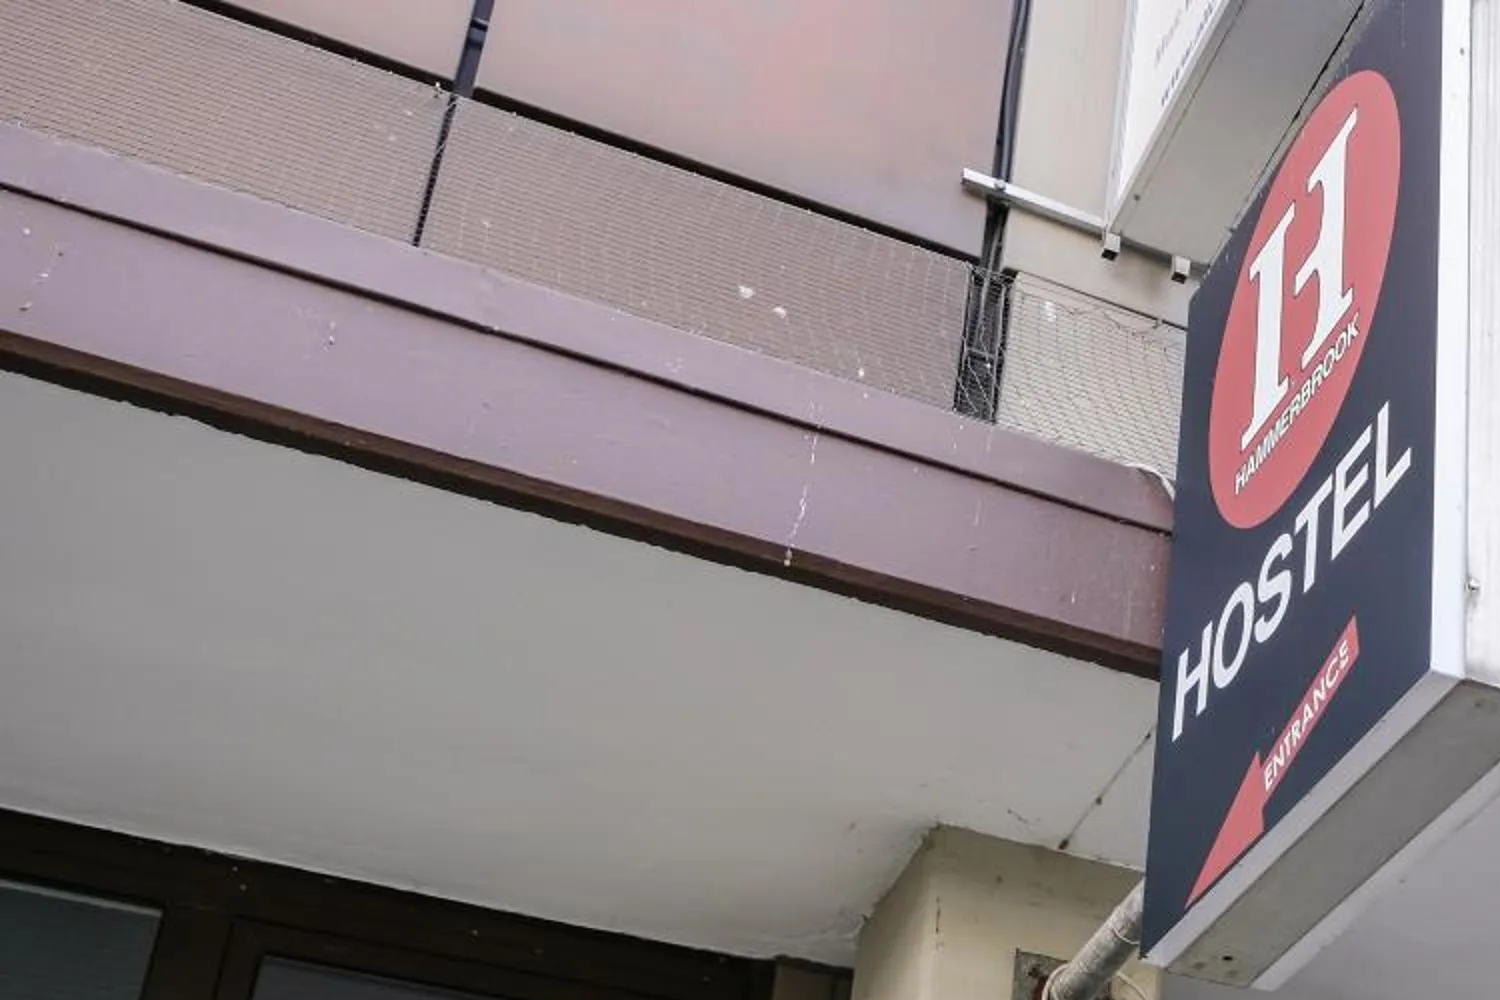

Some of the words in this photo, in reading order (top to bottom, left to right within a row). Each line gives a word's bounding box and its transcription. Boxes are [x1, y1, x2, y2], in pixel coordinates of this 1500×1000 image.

[1234, 312, 1360, 495] HAMMERBROOK
[1172, 401, 1412, 743] HOSTEL
[1263, 639, 1350, 792] ENTRANCE
